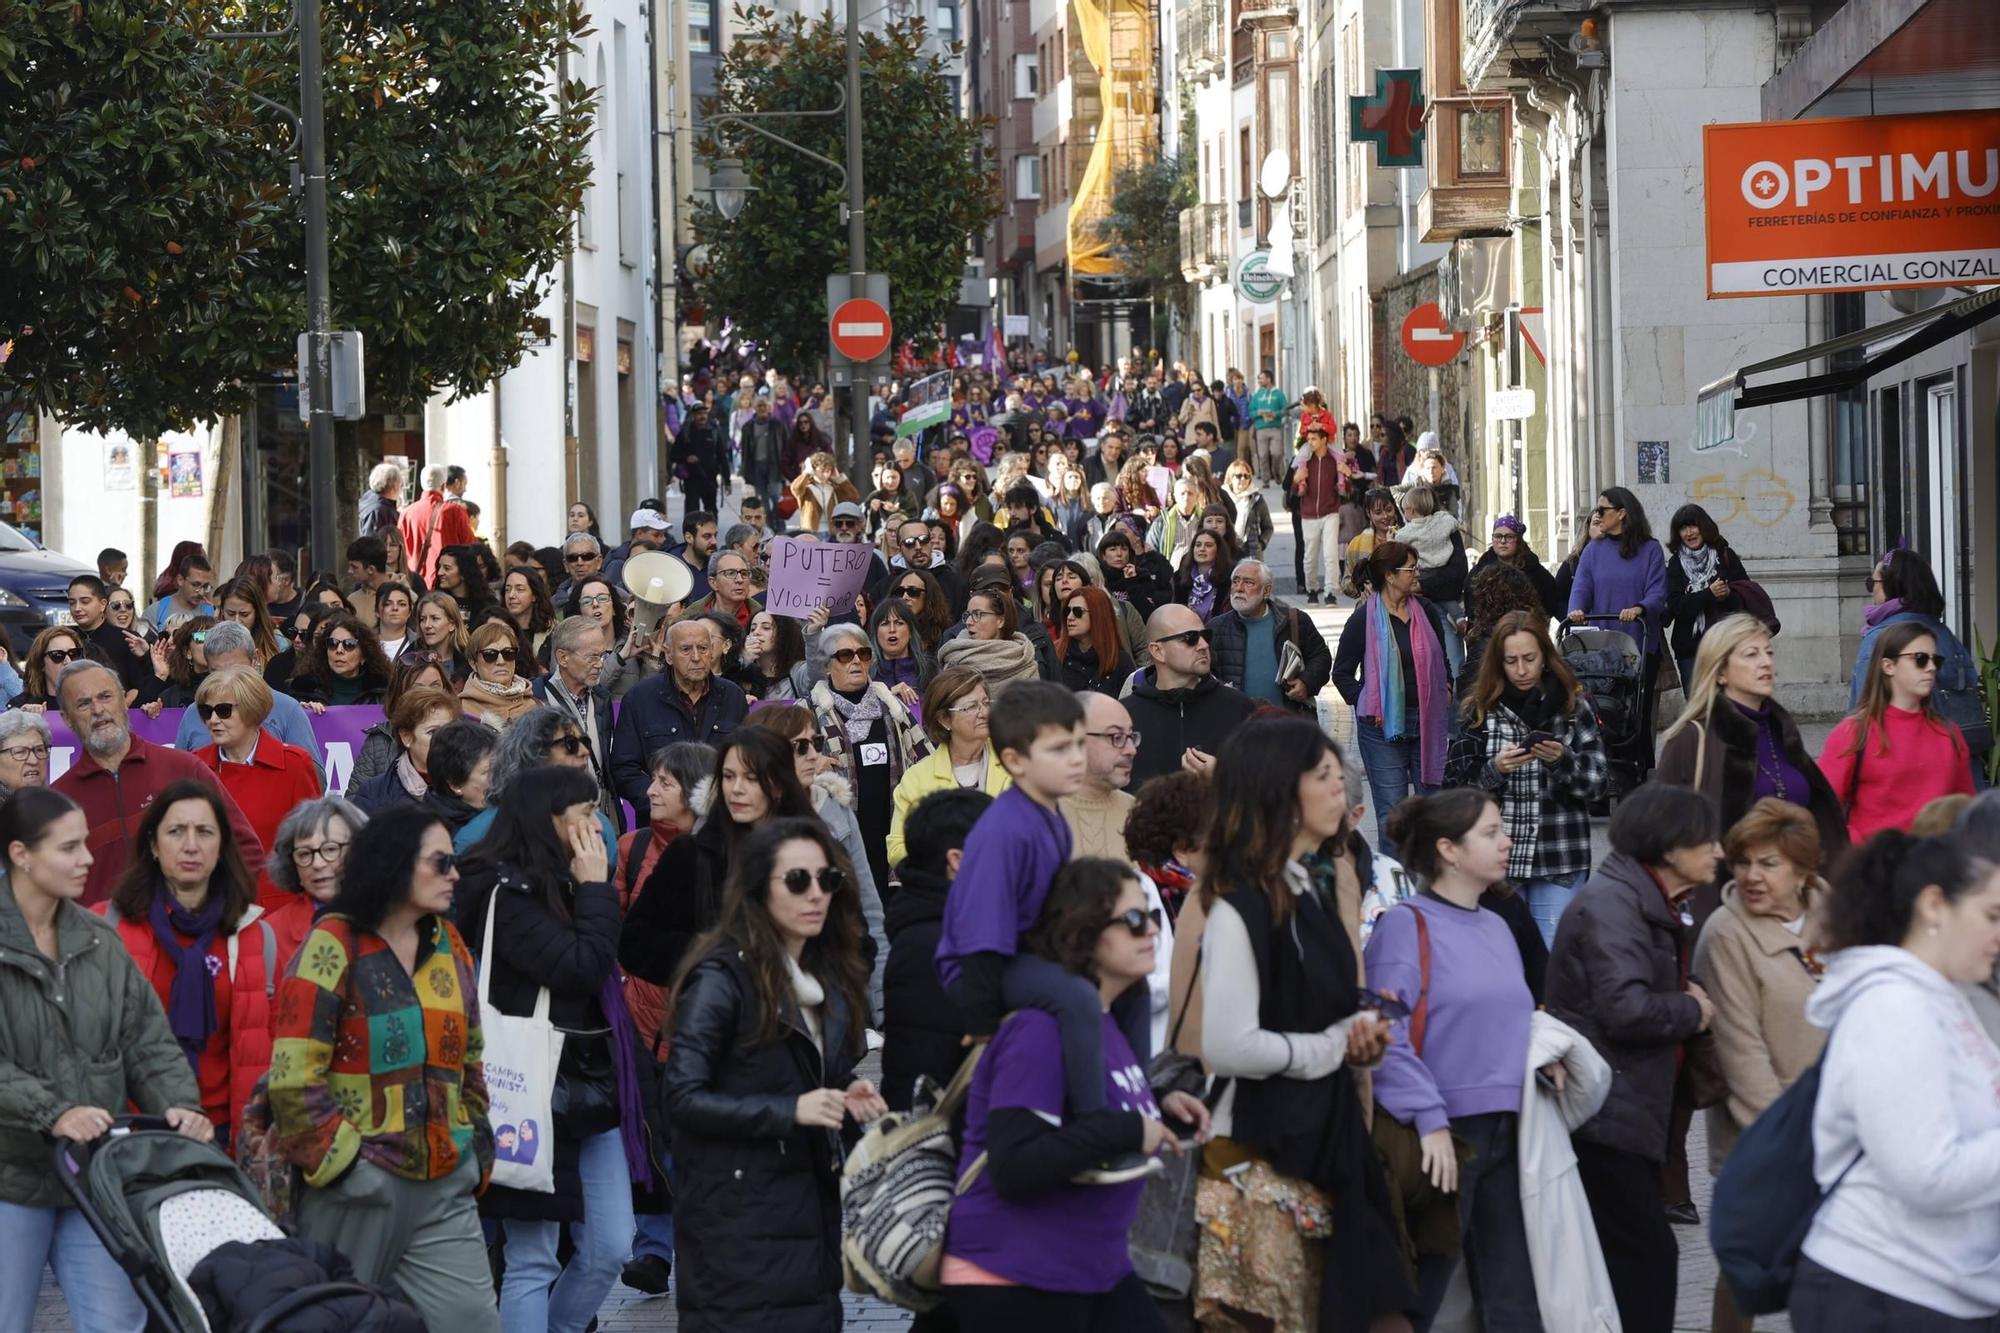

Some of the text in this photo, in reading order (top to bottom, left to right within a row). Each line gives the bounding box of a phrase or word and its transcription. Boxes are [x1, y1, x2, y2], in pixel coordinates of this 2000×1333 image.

[1741, 149, 1998, 209] OPTIMU
[1748, 212, 1835, 228] FERRETERÍAS
[1839, 212, 1856, 224] DE
[1860, 207, 1940, 222] CONFIANZA
[1944, 206, 1953, 217] Y
[1763, 258, 2000, 287] COMERCIAL GONZAL
[1694, 467, 1796, 528] 5G
[783, 541, 866, 573] PUTERO
[771, 588, 852, 608] VIOLADOR
[485, 1062, 525, 1082] CAMPUS
